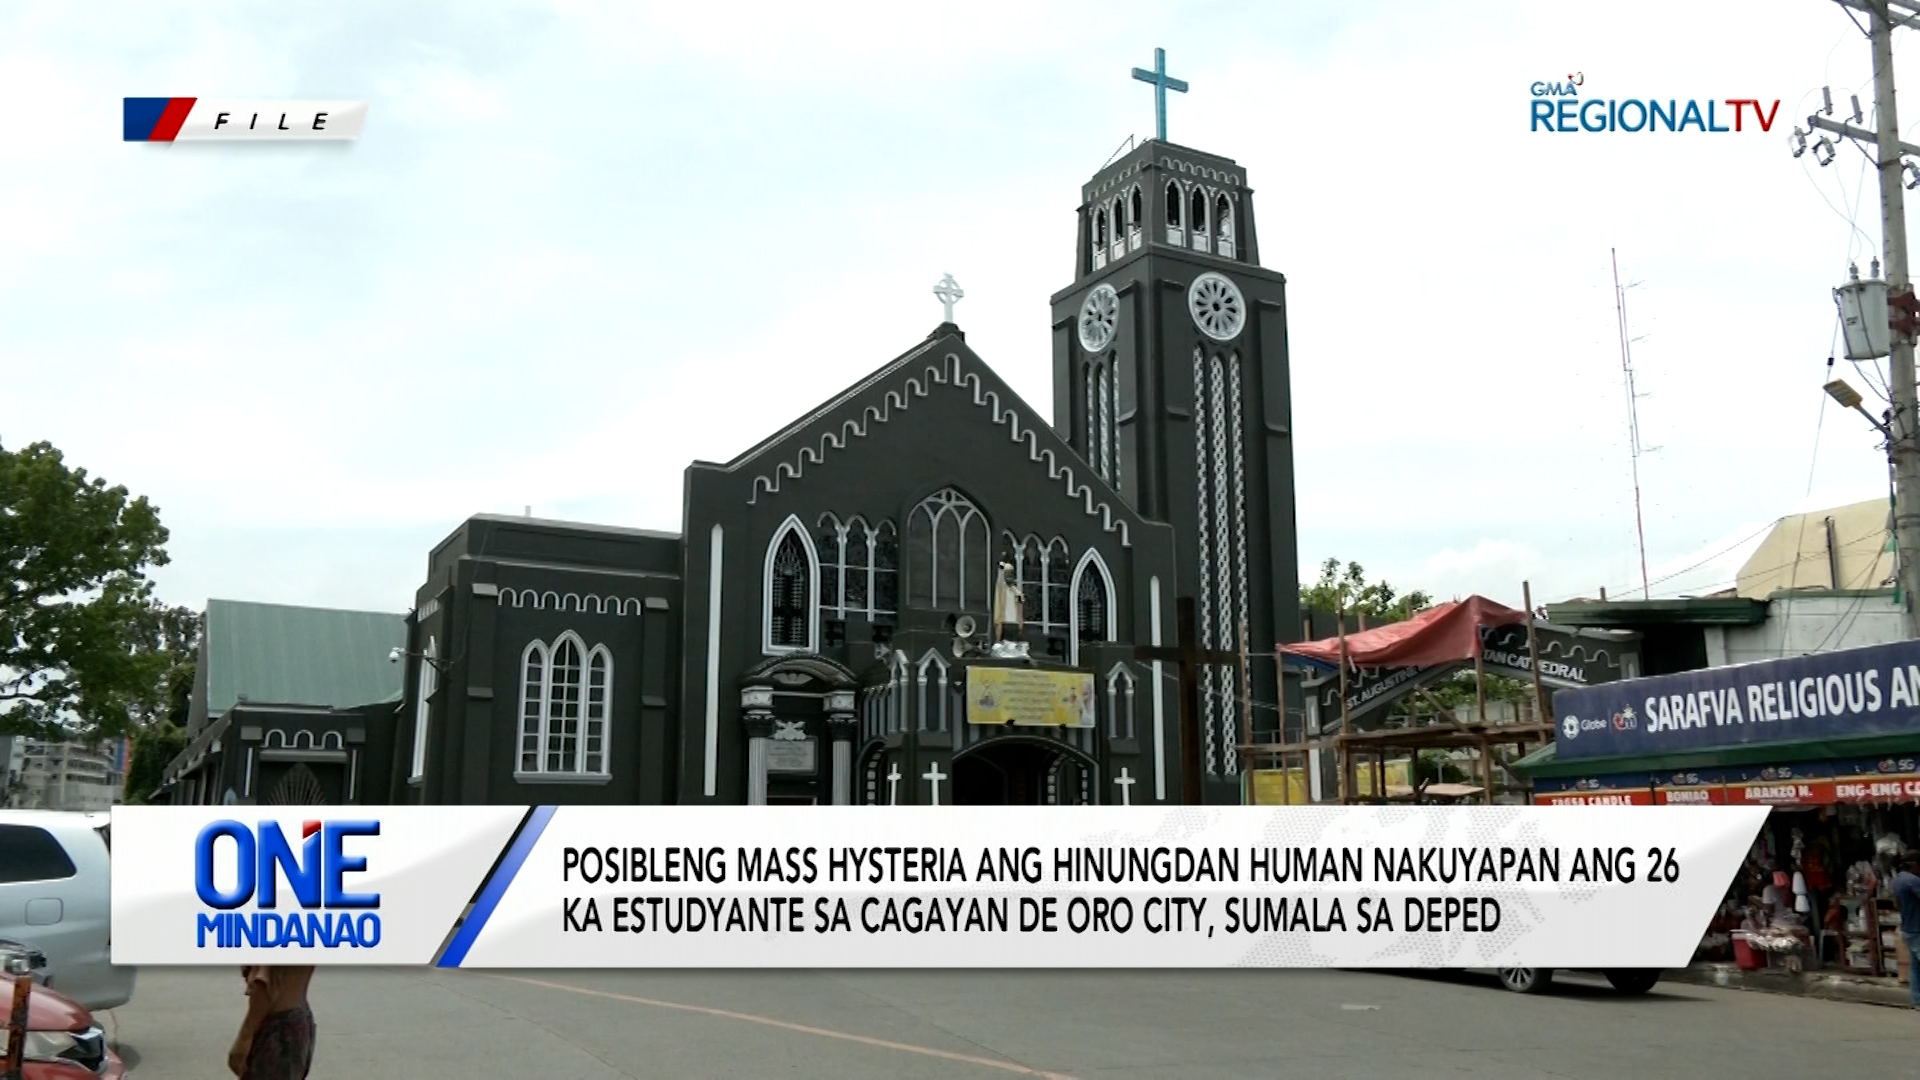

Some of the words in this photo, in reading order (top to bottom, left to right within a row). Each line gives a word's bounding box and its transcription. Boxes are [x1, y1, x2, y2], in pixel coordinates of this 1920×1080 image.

[1506, 652, 1588, 682] CATEDRAL
[1645, 687, 1744, 733] SARAFVA
[1747, 668, 1883, 724] RELIGIOUS
[1581, 718, 1608, 732] Globe
[1836, 782, 1901, 798] ENG-ENG
